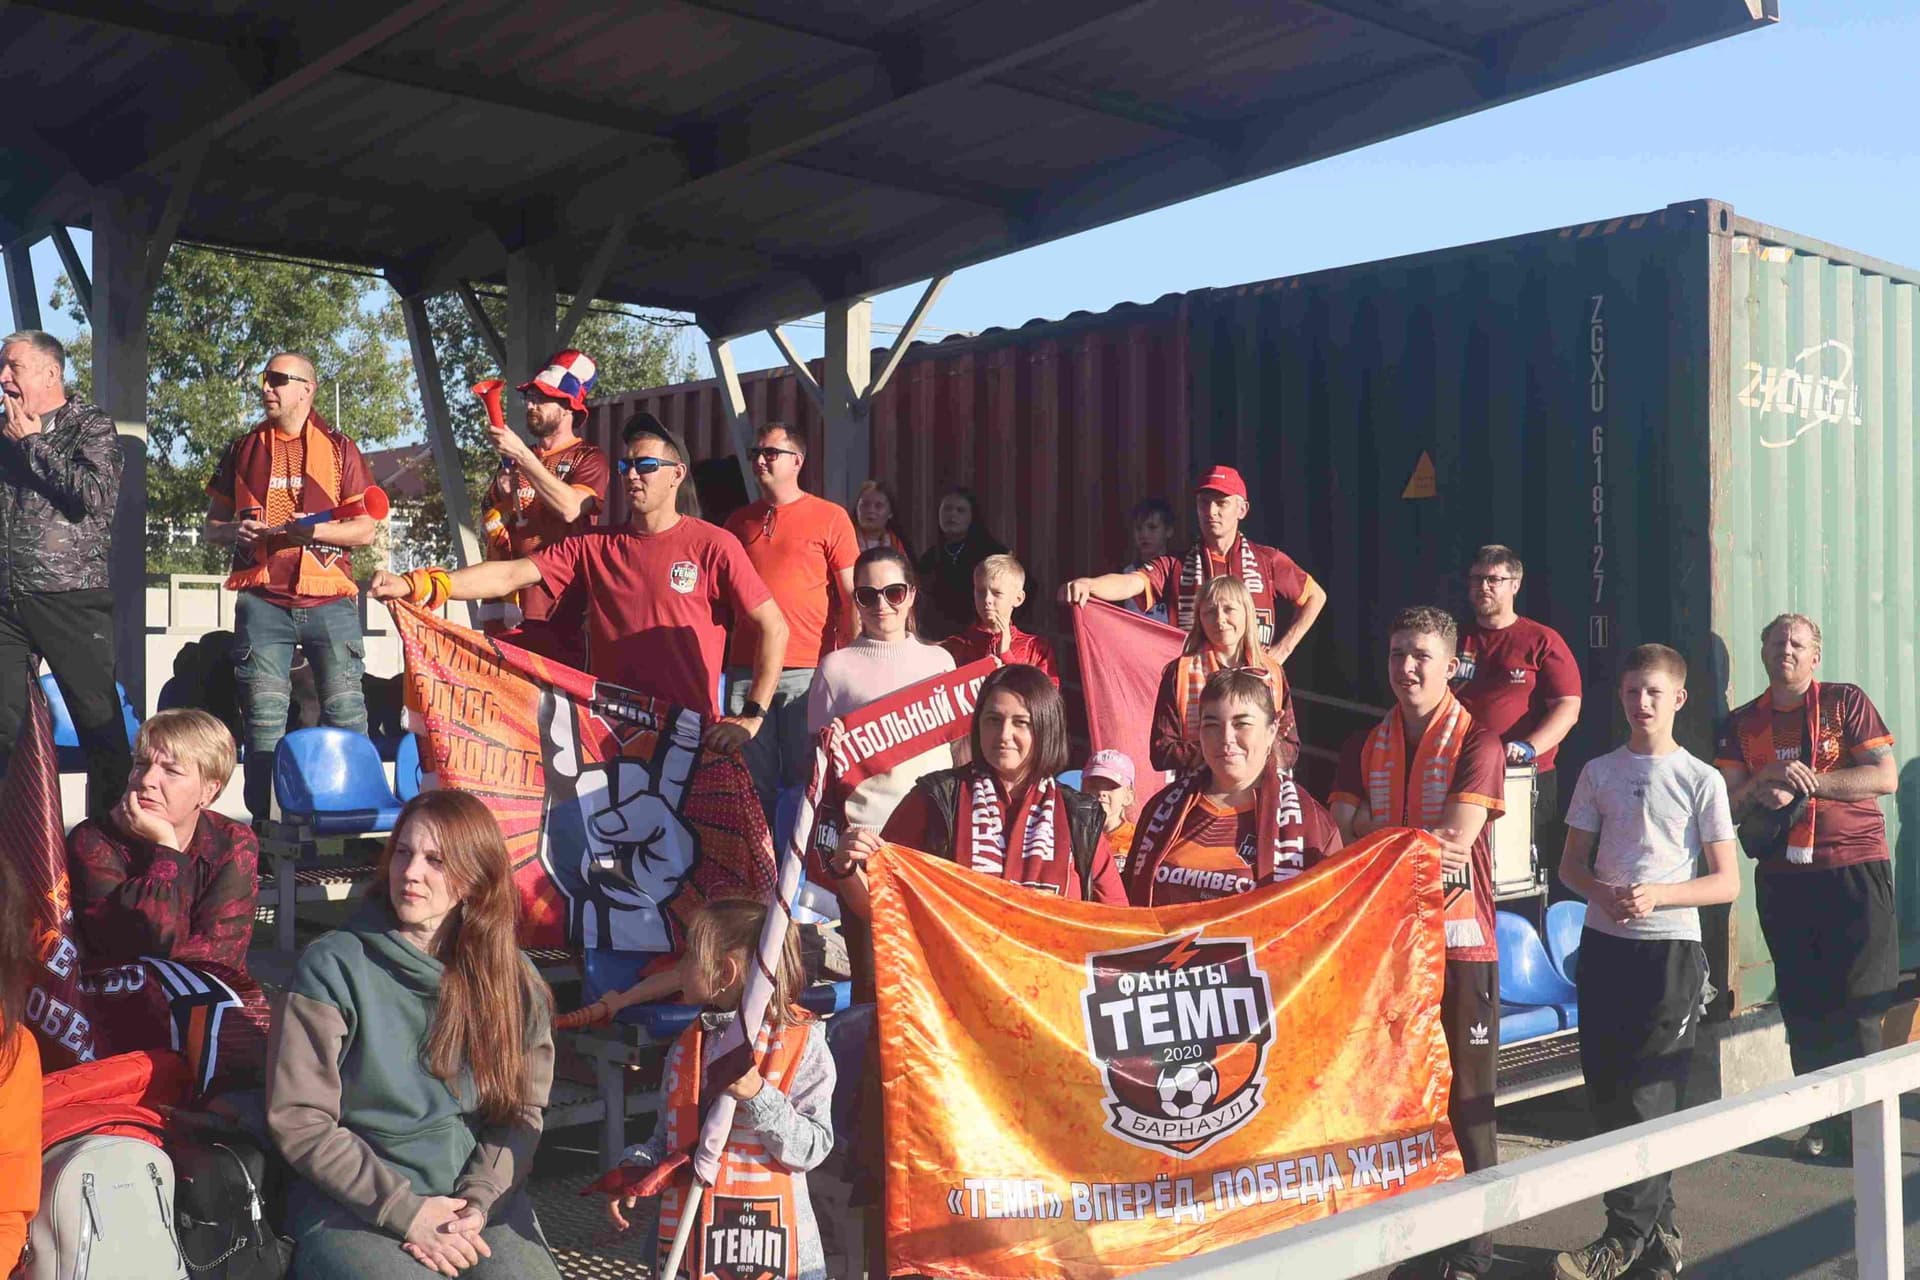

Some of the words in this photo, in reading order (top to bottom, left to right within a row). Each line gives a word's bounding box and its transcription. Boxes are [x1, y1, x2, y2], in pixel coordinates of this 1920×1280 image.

[1591, 295, 1604, 411] ZGXU
[1592, 425, 1604, 602] 618127
[446, 733, 543, 788] ХОДЯТ
[1155, 866, 1257, 894] ОДИНВЕС
[1118, 964, 1228, 996] ФАНАТЫ
[1100, 987, 1261, 1051] ТЕМП
[1163, 1044, 1202, 1062] 2020
[1132, 1102, 1243, 1137] БАРНАУЛ
[947, 1177, 1064, 1219] «ТЕМП»
[1071, 1173, 1205, 1224] ВПЕРЁД,
[1212, 1152, 1344, 1210] ПОБЕДА
[1347, 1129, 1437, 1191] ЖДЕТ!
[711, 1228, 781, 1268] ТЕМП
